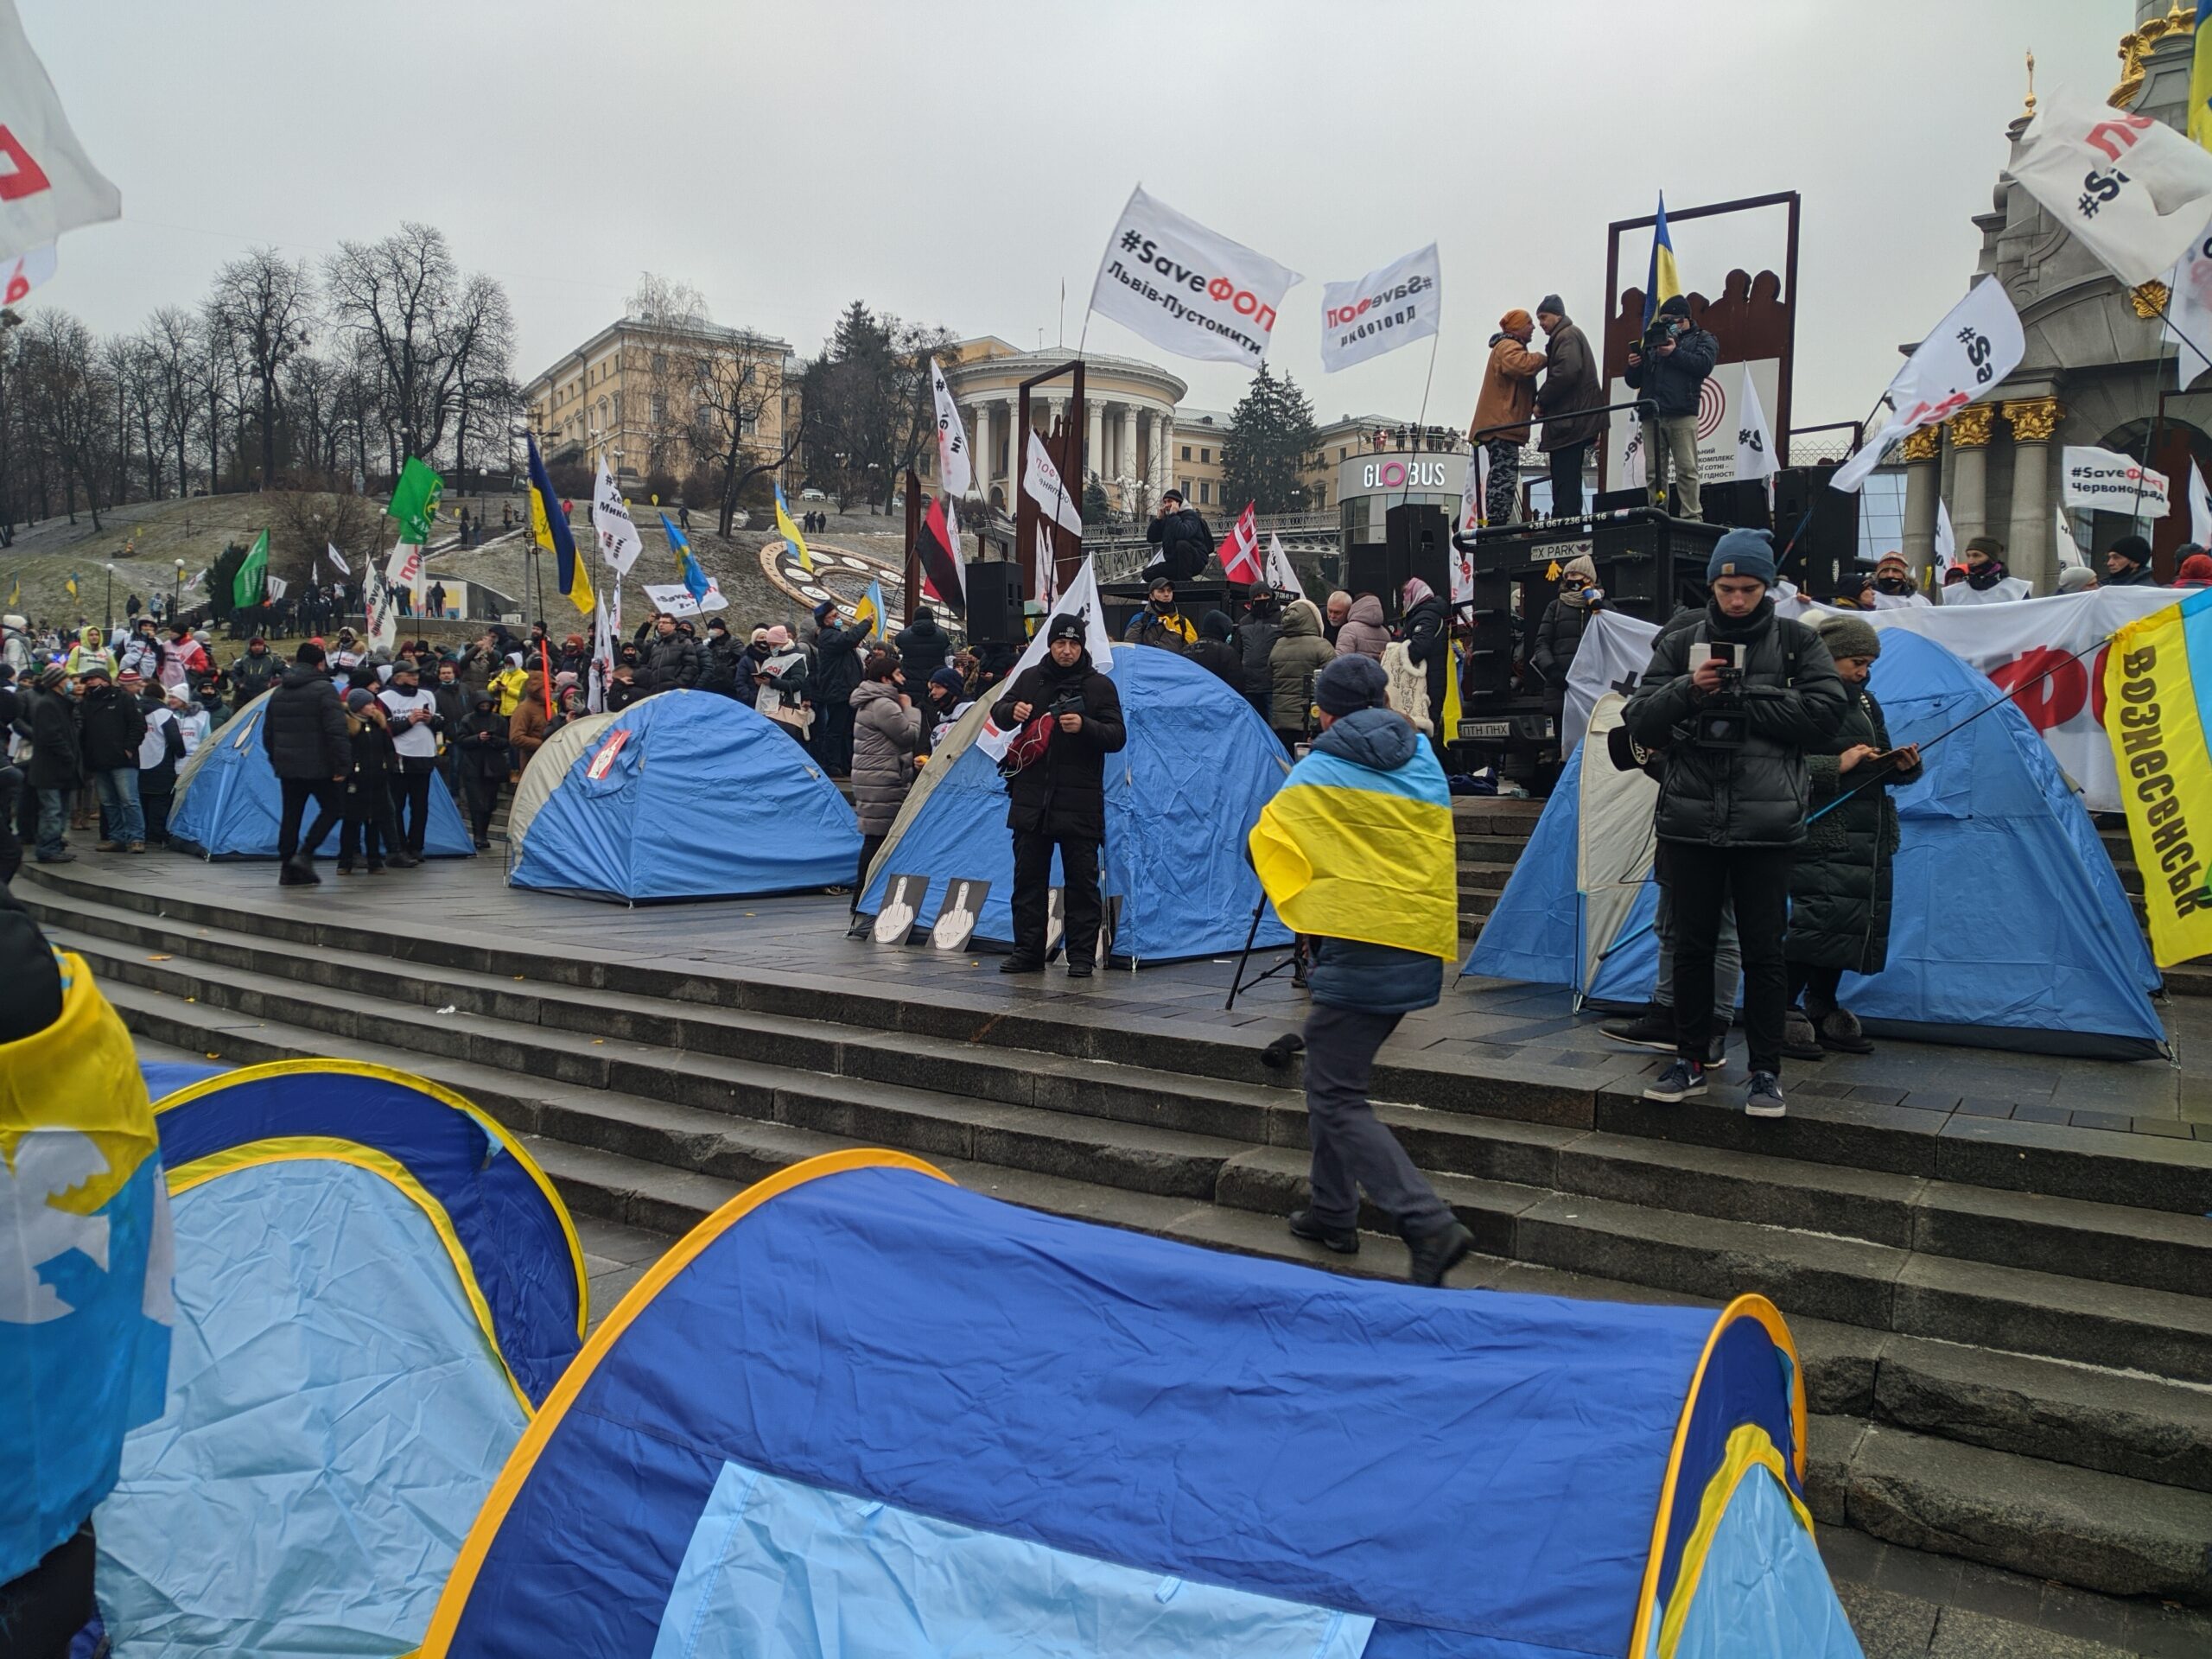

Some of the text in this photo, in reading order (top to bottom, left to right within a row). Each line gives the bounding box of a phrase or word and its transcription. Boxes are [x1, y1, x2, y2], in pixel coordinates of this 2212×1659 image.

[1119, 228, 1277, 333] #SaveФОП
[1106, 260, 1262, 356] Львів-Пустомити
[1364, 460, 1446, 488] GLOBUS
[1546, 518, 1561, 528] 067
[1564, 516, 1580, 525] 236
[1582, 514, 1592, 523] 41
[1596, 512, 1607, 521] 16
[1548, 543, 1575, 557] PARK
[1462, 723, 1508, 737] ПТН ПНХ
